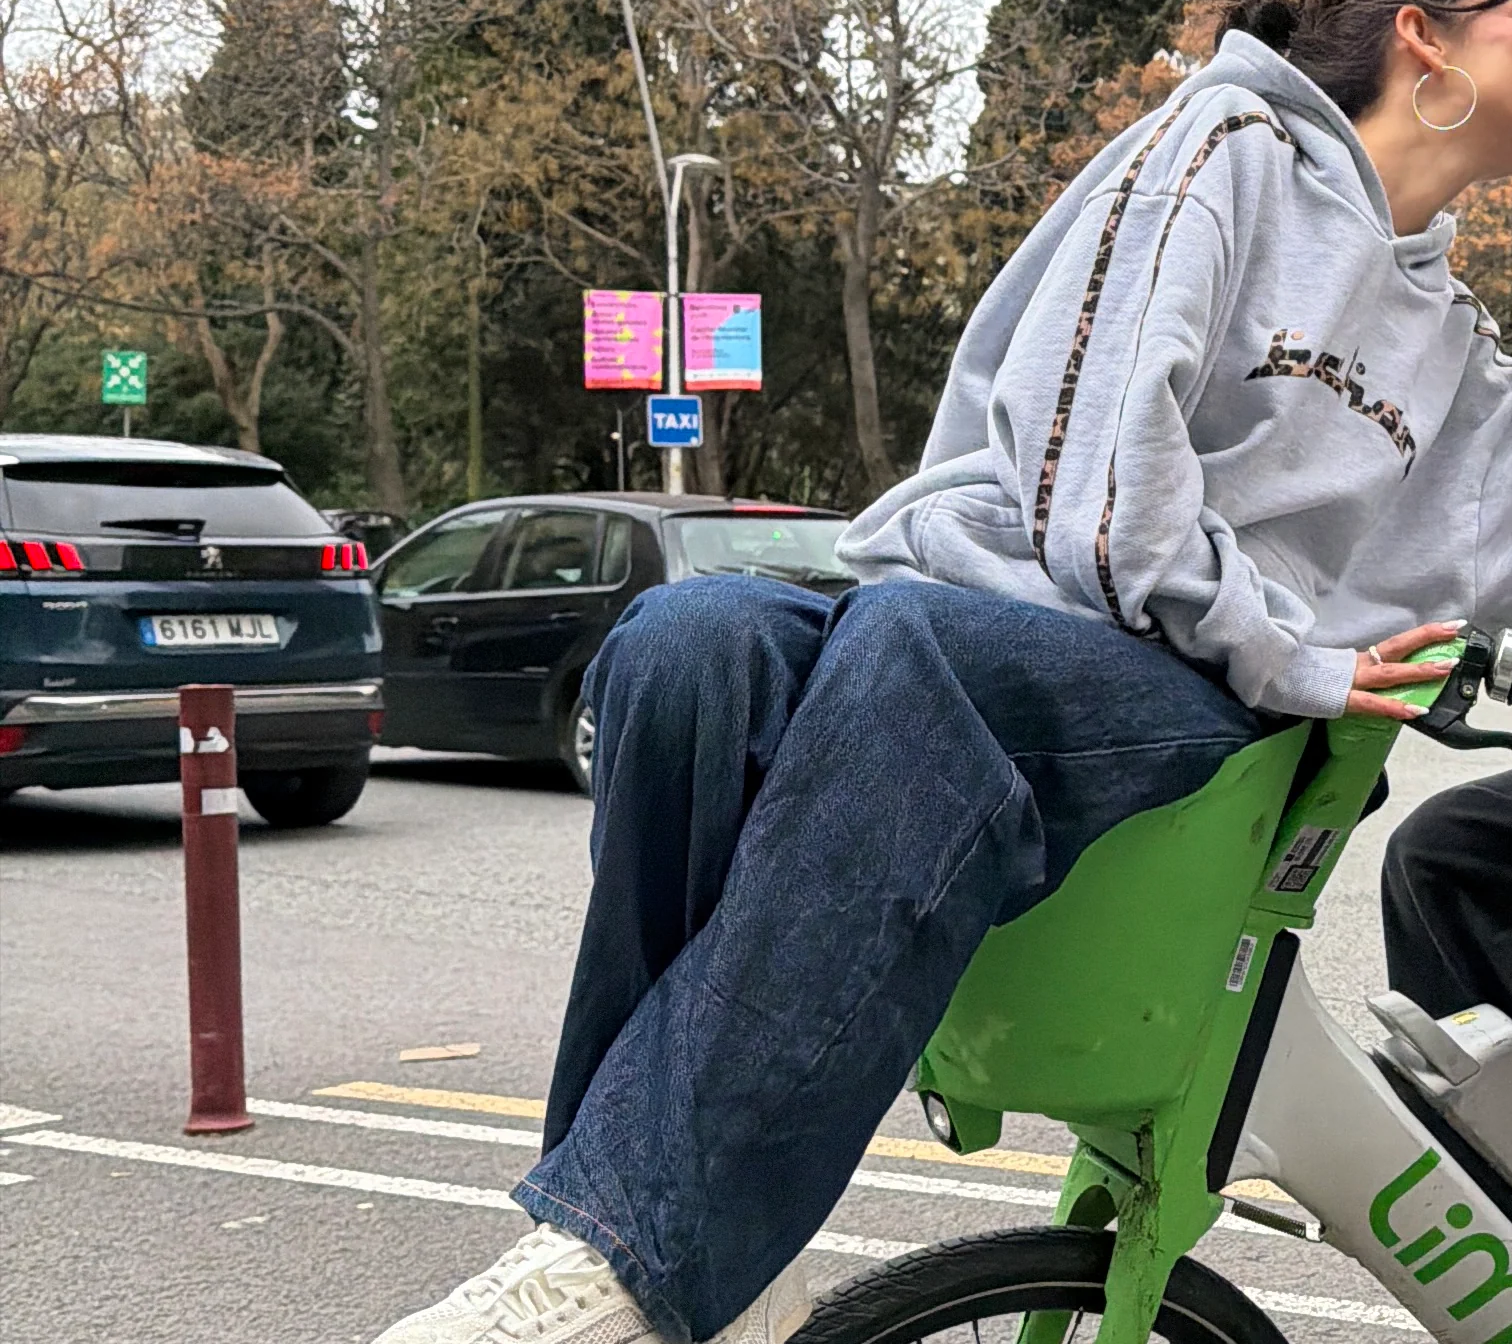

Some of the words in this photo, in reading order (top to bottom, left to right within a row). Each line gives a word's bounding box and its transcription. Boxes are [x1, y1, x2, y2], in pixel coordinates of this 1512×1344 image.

[653, 412, 698, 430] TAXI
[160, 618, 220, 641] 6161
[227, 616, 273, 639] MJL
